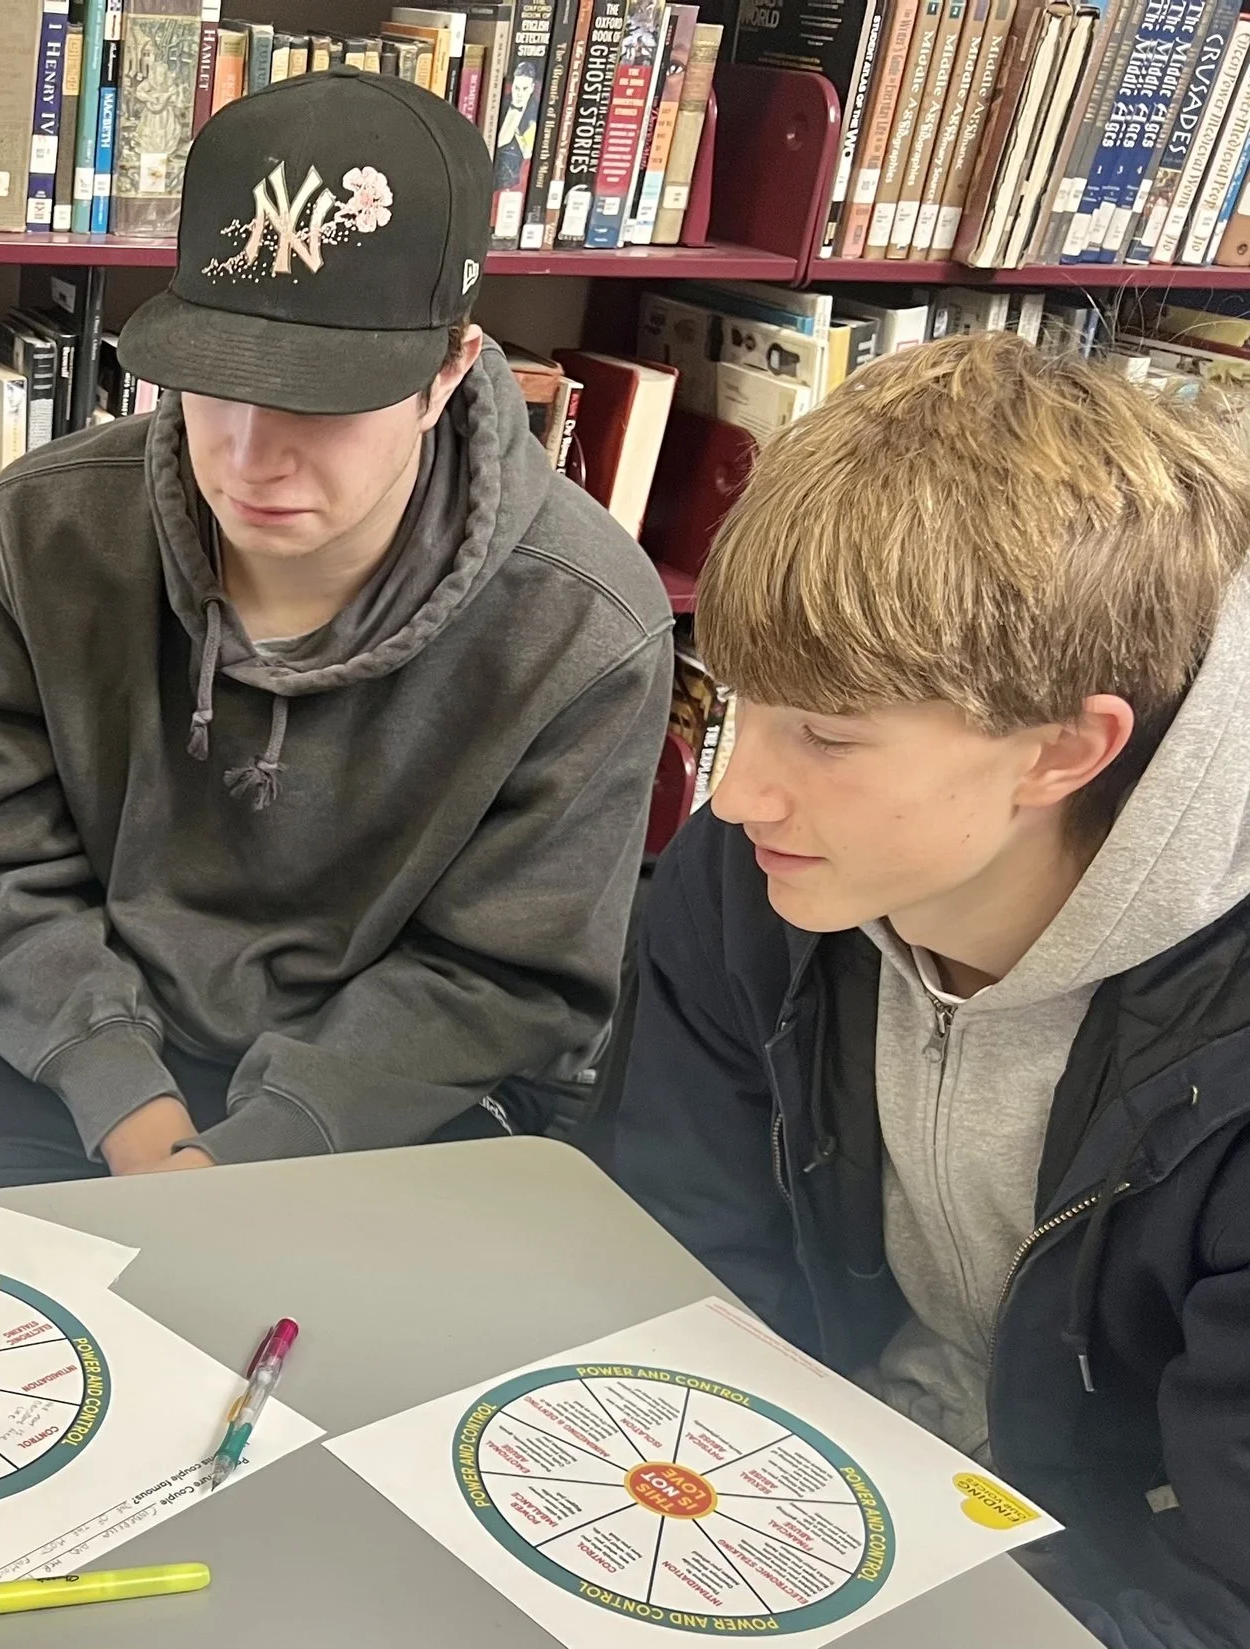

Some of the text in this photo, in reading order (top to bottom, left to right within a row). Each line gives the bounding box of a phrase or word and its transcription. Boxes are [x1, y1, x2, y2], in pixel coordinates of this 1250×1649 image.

[595, 17, 622, 28] OXFORD
[606, 4, 620, 15] THE
[741, 10, 780, 28] WORLD
[1142, 0, 1162, 31] The
[1163, 0, 1187, 33] The
[1182, 1, 1205, 33] The
[592, 30, 621, 42] BOOK OF
[199, 29, 217, 92] HAMLET
[850, 15, 881, 129] STUDENT ATLAS OF THE
[911, 31, 934, 93] Middle
[934, 34, 957, 96] Middle
[958, 37, 981, 99] Middle
[979, 36, 1002, 97] Middle
[1119, 34, 1157, 97] Middle
[1140, 39, 1176, 97] Middle
[1160, 37, 1191, 97] Middle
[40, 42, 61, 134] HENRY IV
[1169, 34, 1224, 155] CRUSADES
[101, 93, 114, 148] MACBETH
[570, 45, 608, 174] GHOST STORIES
[1102, 101, 1127, 148] Ages
[1123, 103, 1149, 148] Ages
[1142, 102, 1167, 148] Ages
[886, 121, 906, 183] Biographies
[908, 124, 930, 186] Biographies
[1117, 166, 1124, 175] 3
[1136, 165, 1143, 175] 4
[244, 160, 338, 275] NY
[2, 1320, 39, 1338] STALKING
[6, 1323, 54, 1346] ELECTRONIC
[21, 1364, 78, 1392] INTIMIDATION
[61, 1337, 103, 1446] POWER AND CONTROL
[576, 1366, 752, 1406] POWER AND CONTROL
[523, 1395, 558, 1422] DENYING
[17, 1425, 59, 1449] CONTROL
[563, 1423, 611, 1458] MINIMIZING
[620, 1417, 663, 1448] ISOLATION
[685, 1431, 725, 1461] PHYSICAL
[700, 1433, 727, 1453] ABUSE
[459, 1402, 498, 1508] POWER AND CONTROL
[485, 1440, 531, 1474] EMOTIONAL
[501, 1443, 529, 1463] ABUSE
[133, 1463, 202, 1505] couple famous?
[160, 1485, 195, 1506] Couple
[635, 1483, 675, 1511] THIS
[641, 1471, 698, 1511] IS NOT
[661, 1468, 707, 1500] LOVE
[739, 1471, 772, 1495] SEXUAL
[748, 1469, 779, 1489] ABUSE
[511, 1491, 559, 1527] IMBALANCE
[511, 1502, 541, 1525] POWER
[957, 1480, 1020, 1522] FINDING
[965, 1477, 1027, 1520] OUR VOICES
[768, 1519, 814, 1552] FINANCIAL
[784, 1521, 814, 1542] ABUSE
[839, 1466, 887, 1584] POWER AND CONTROL
[577, 1541, 617, 1574] CONTROL
[717, 1539, 810, 1605] ELECTRONIC STALKING
[661, 1560, 723, 1607] INTIMIDATION
[579, 1580, 780, 1631] POWER AND CONTROL
